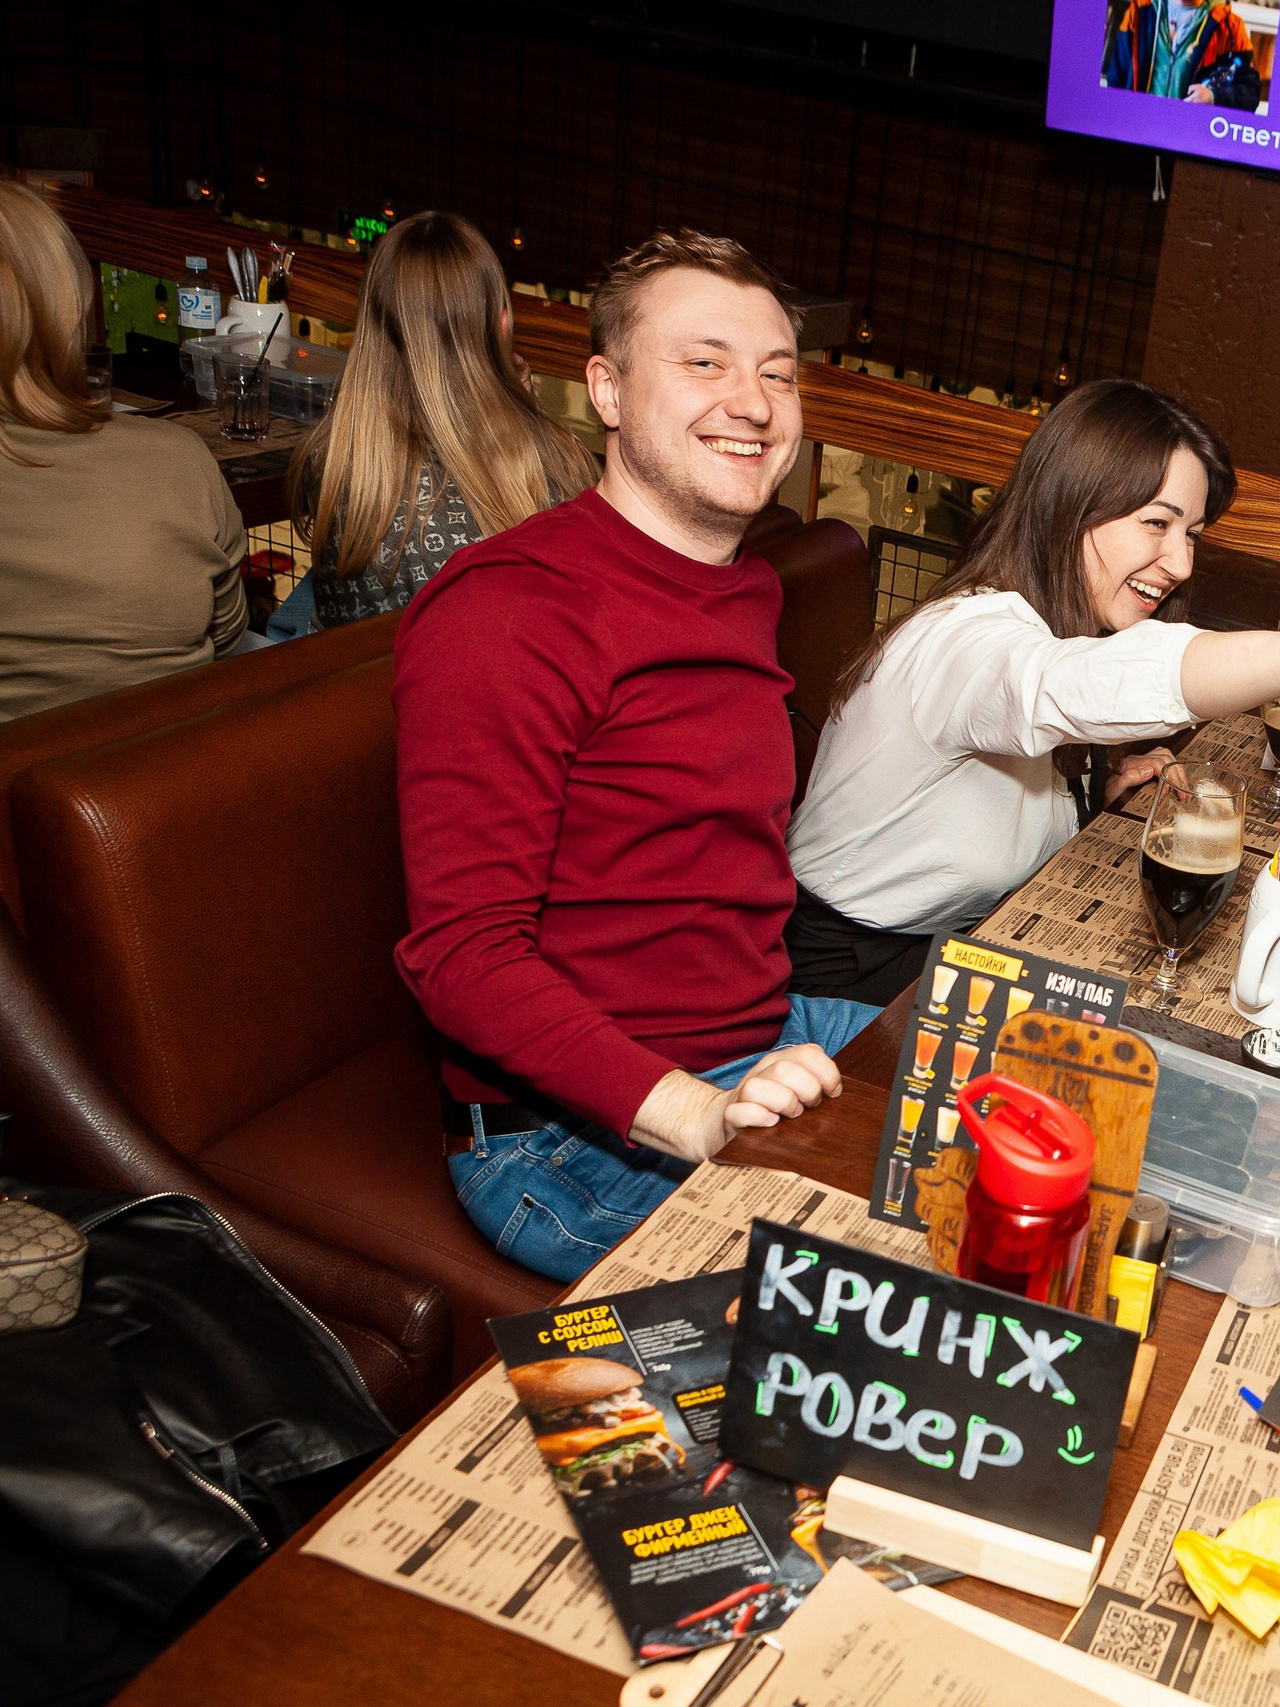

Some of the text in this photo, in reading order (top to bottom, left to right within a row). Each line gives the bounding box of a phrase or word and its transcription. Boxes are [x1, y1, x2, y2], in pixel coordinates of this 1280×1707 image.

[953, 948, 1007, 975] НАСТОЙКИ
[1045, 971, 1115, 1008] ИЗИ ПАБ
[537, 1330, 551, 1345] С
[552, 1317, 617, 1341] СОУСОМ
[554, 1305, 610, 1328] БУРГЕР
[757, 1242, 1083, 1405] КРИНЖ
[566, 1330, 624, 1353] РЕЛИШ
[622, 1504, 740, 1547] БУРГЕР ДЖЕК
[633, 1518, 748, 1559] ФИРМЕННЫЙ
